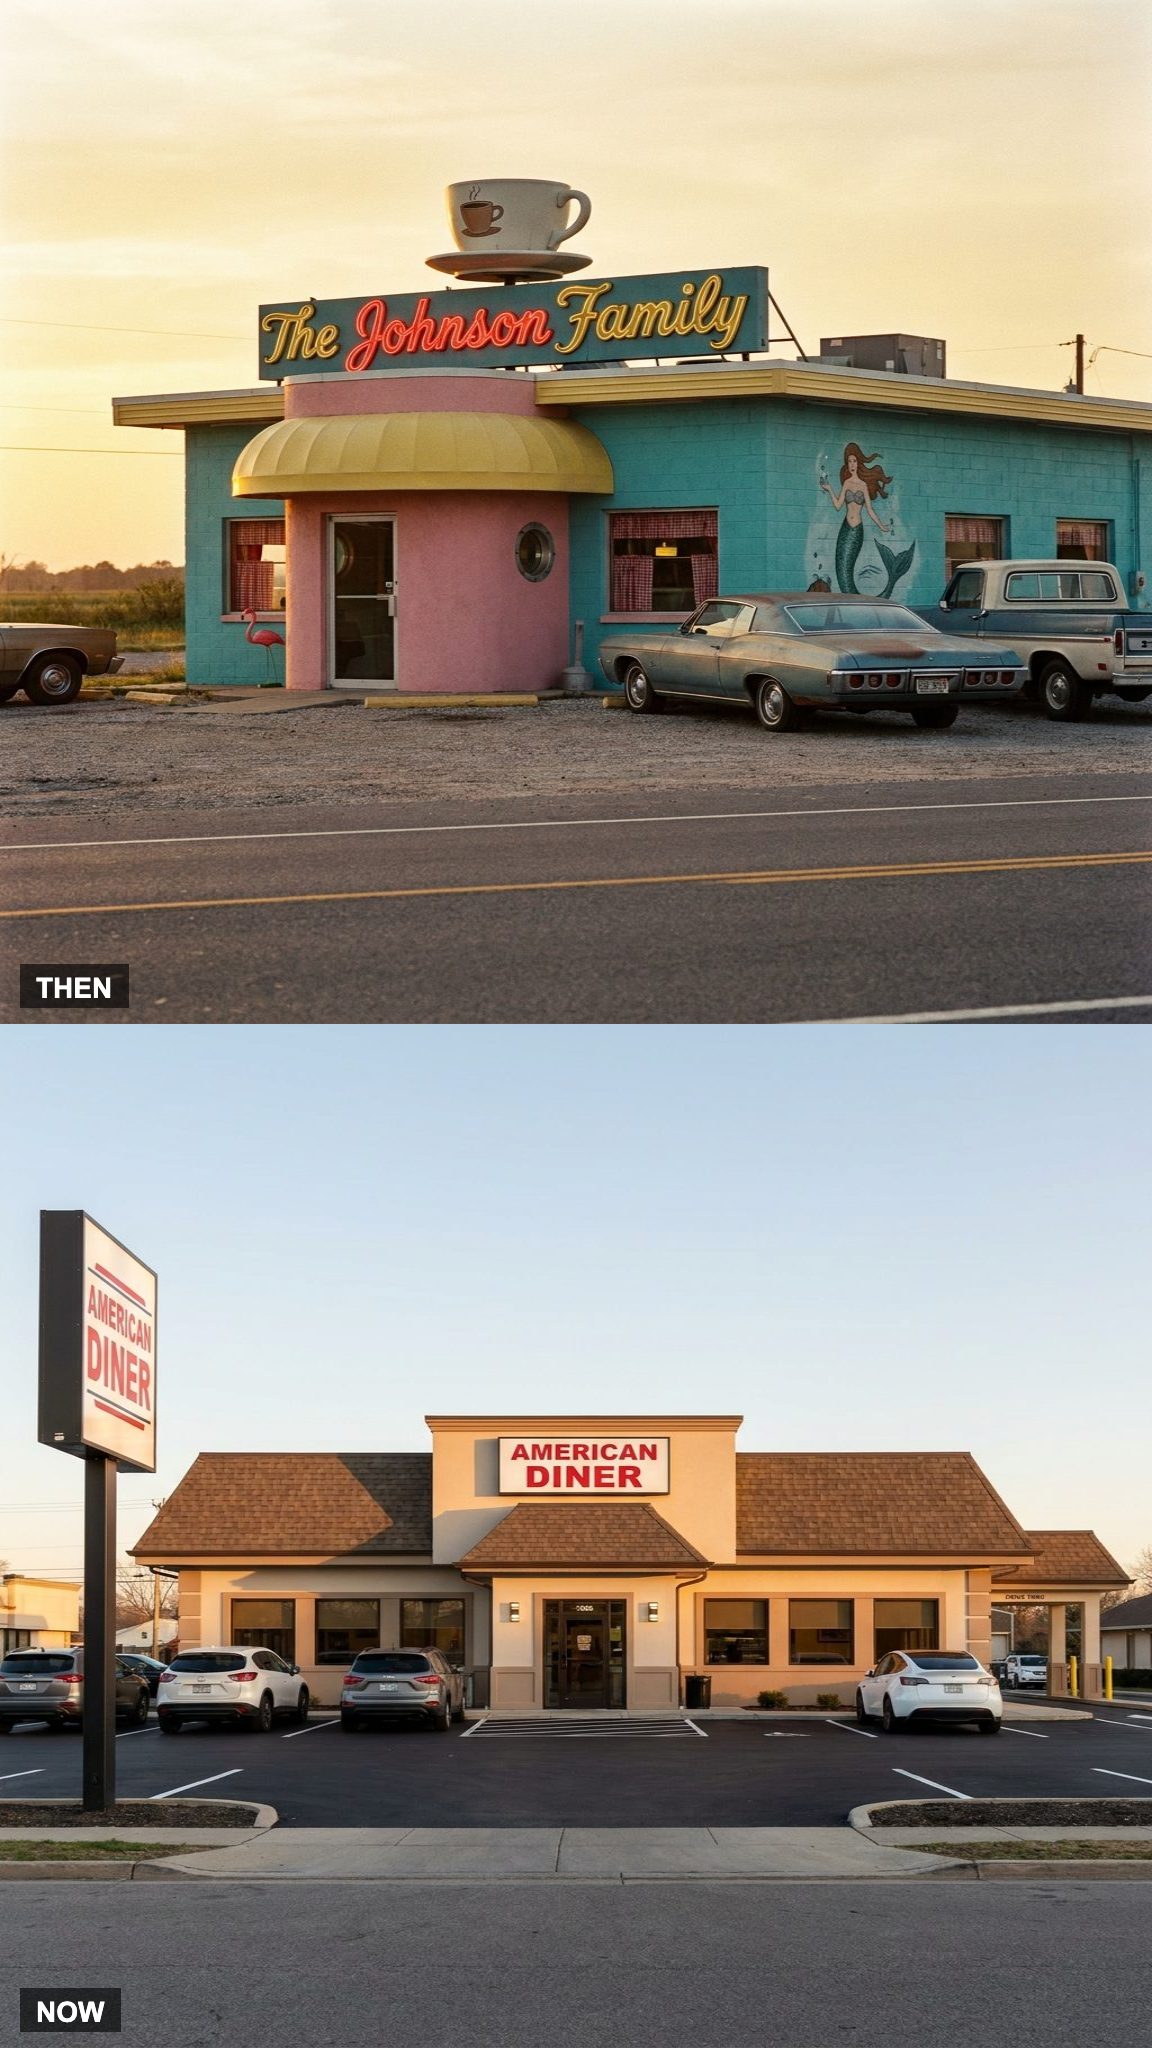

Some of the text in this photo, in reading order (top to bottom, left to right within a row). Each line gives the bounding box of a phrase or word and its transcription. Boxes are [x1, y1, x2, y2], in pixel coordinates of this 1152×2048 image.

[261, 274, 748, 373] The Johnson Family
[87, 1284, 152, 1354] AMERICAN
[87, 1324, 152, 1412] DINER
[510, 1443, 658, 1461] AMERICAN
[525, 1465, 643, 1488] DINER
